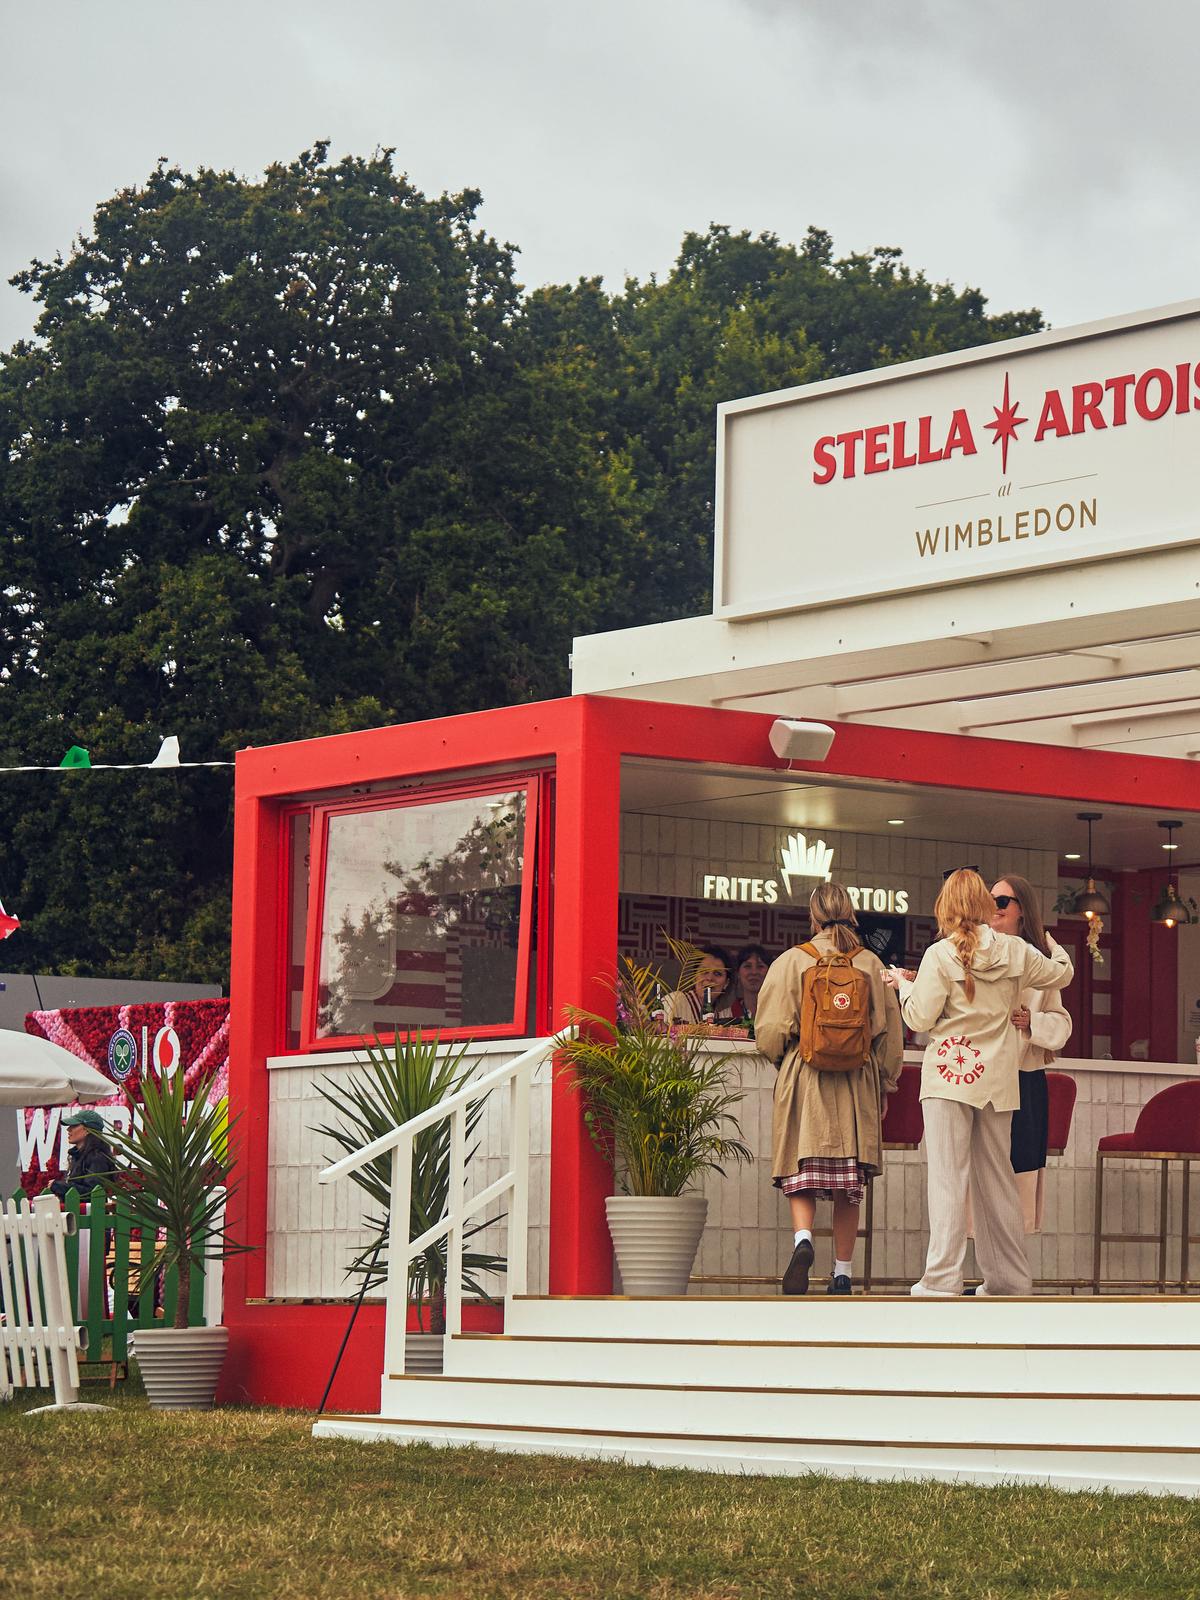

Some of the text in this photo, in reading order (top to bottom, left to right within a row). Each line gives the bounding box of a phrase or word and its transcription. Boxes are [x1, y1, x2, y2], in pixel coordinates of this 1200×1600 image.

[813, 408, 977, 485] STELLA
[997, 481, 1012, 498] at
[915, 497, 1099, 558] WIMBLEDON
[703, 875, 909, 914] FRITES RTOIS
[937, 1035, 981, 1058] STELLA
[936, 1062, 985, 1085] ARTOIS
